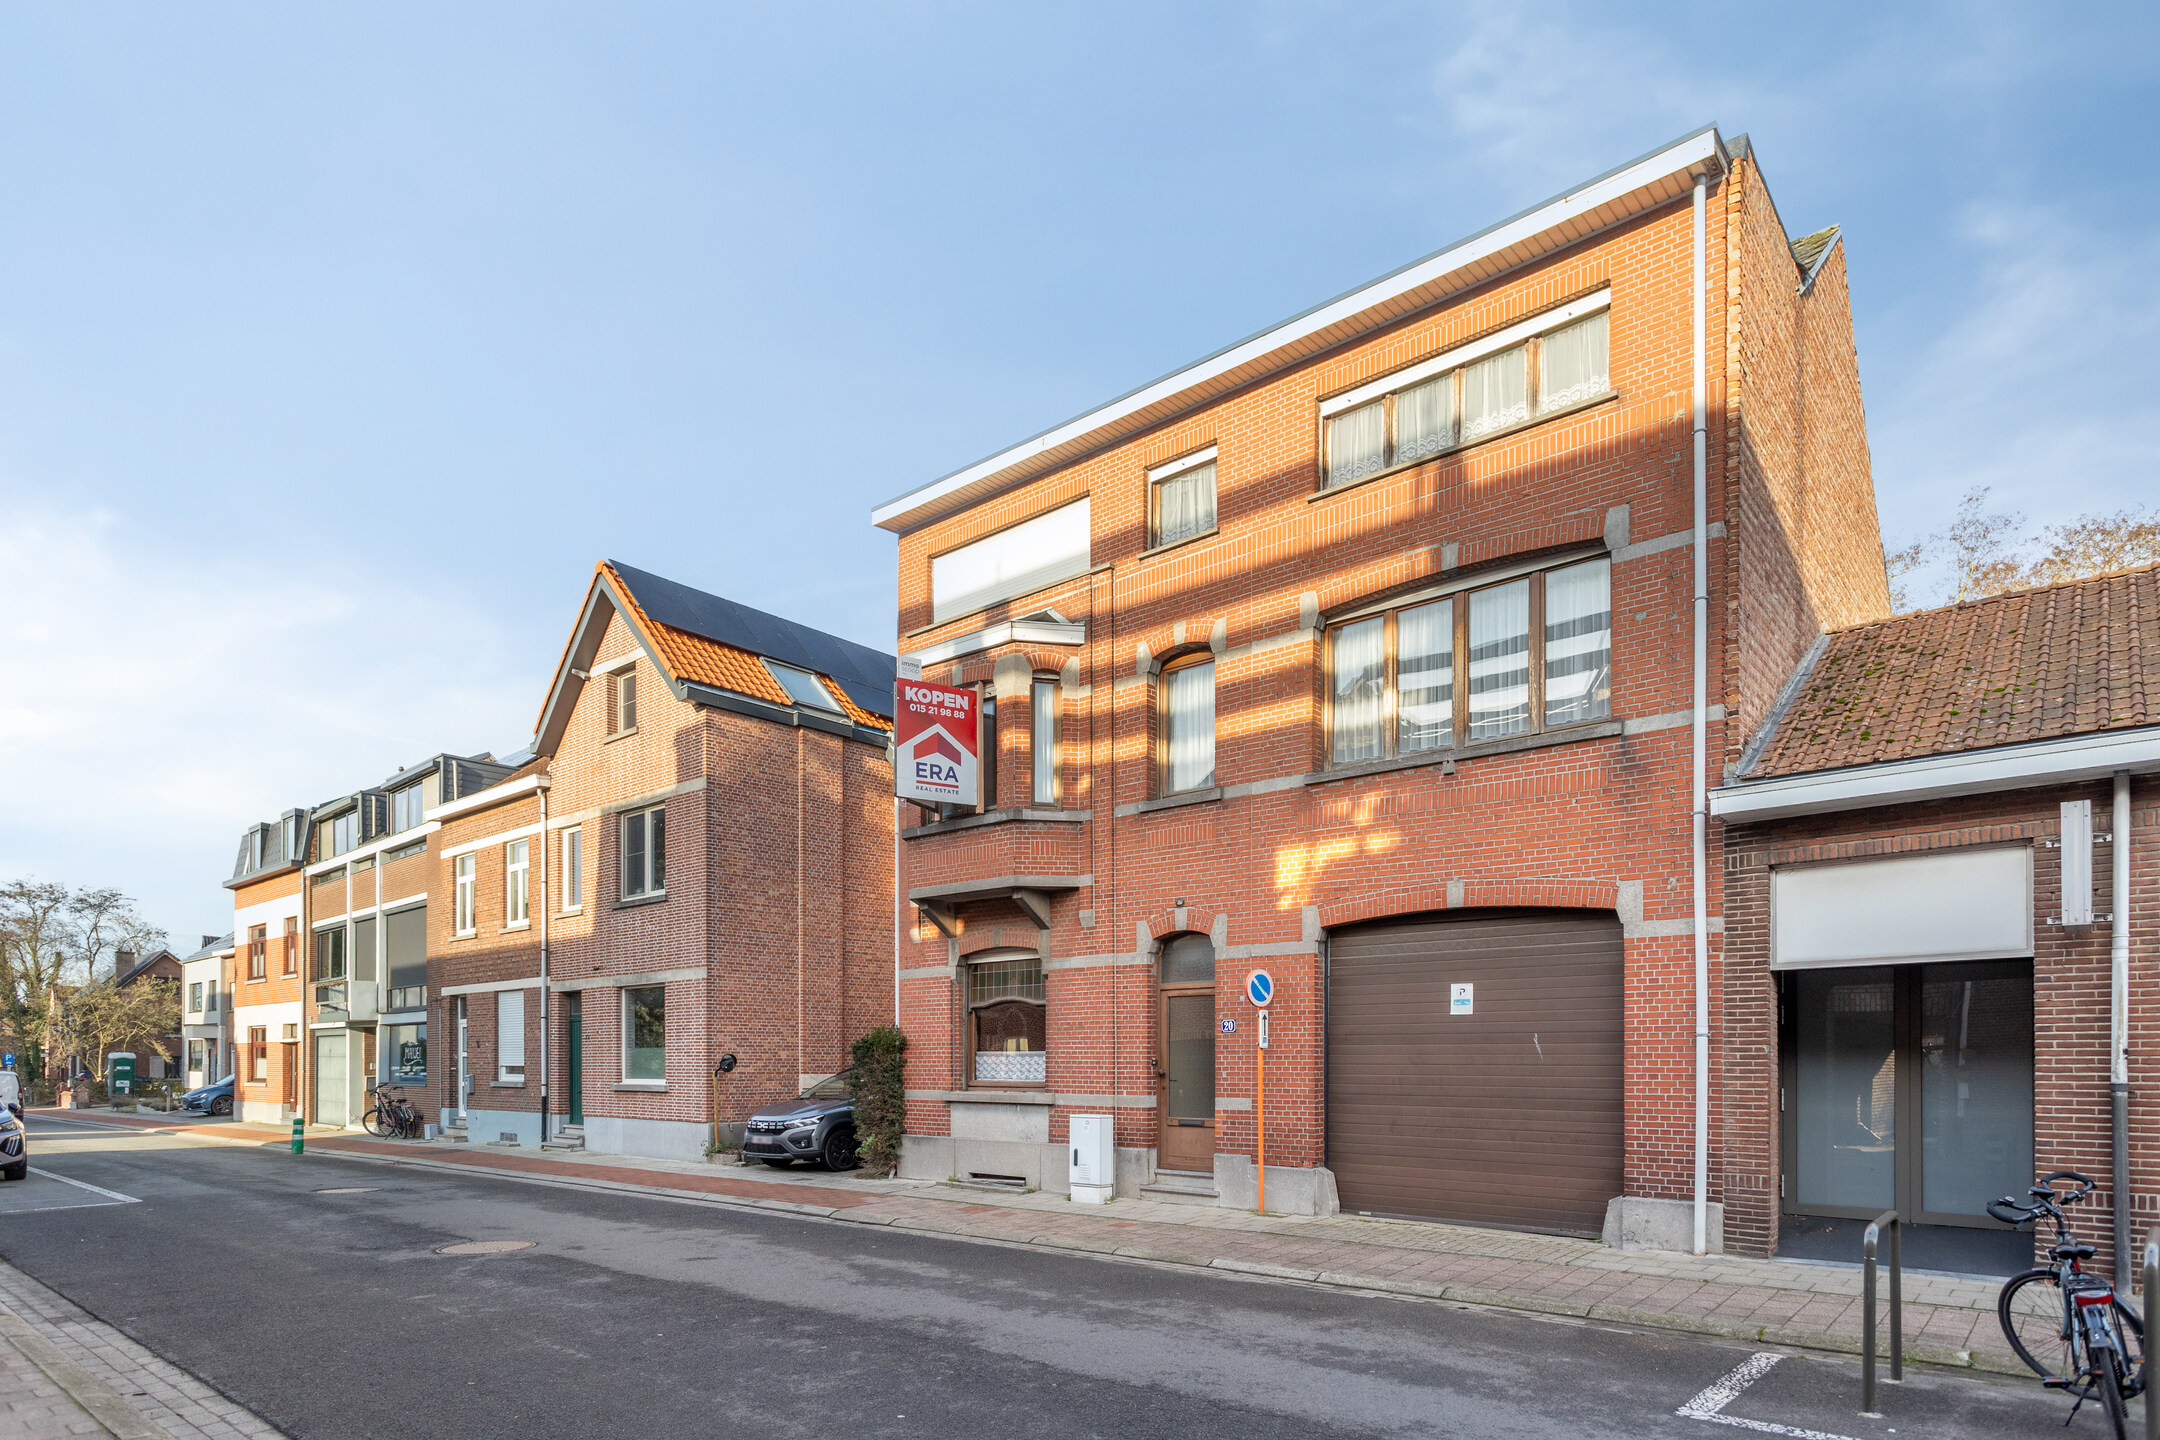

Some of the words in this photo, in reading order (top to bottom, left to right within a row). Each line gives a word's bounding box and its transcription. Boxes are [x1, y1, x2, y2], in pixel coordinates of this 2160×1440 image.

[901, 660, 919, 668] immo
[902, 666, 920, 674] scoop
[905, 686, 969, 710] KOPEN
[909, 703, 926, 713] 015
[928, 706, 938, 715] 21
[940, 708, 952, 717] 98
[954, 710, 965, 719] 88
[916, 761, 959, 783] ERA
[1223, 1021, 1234, 1031] 20
